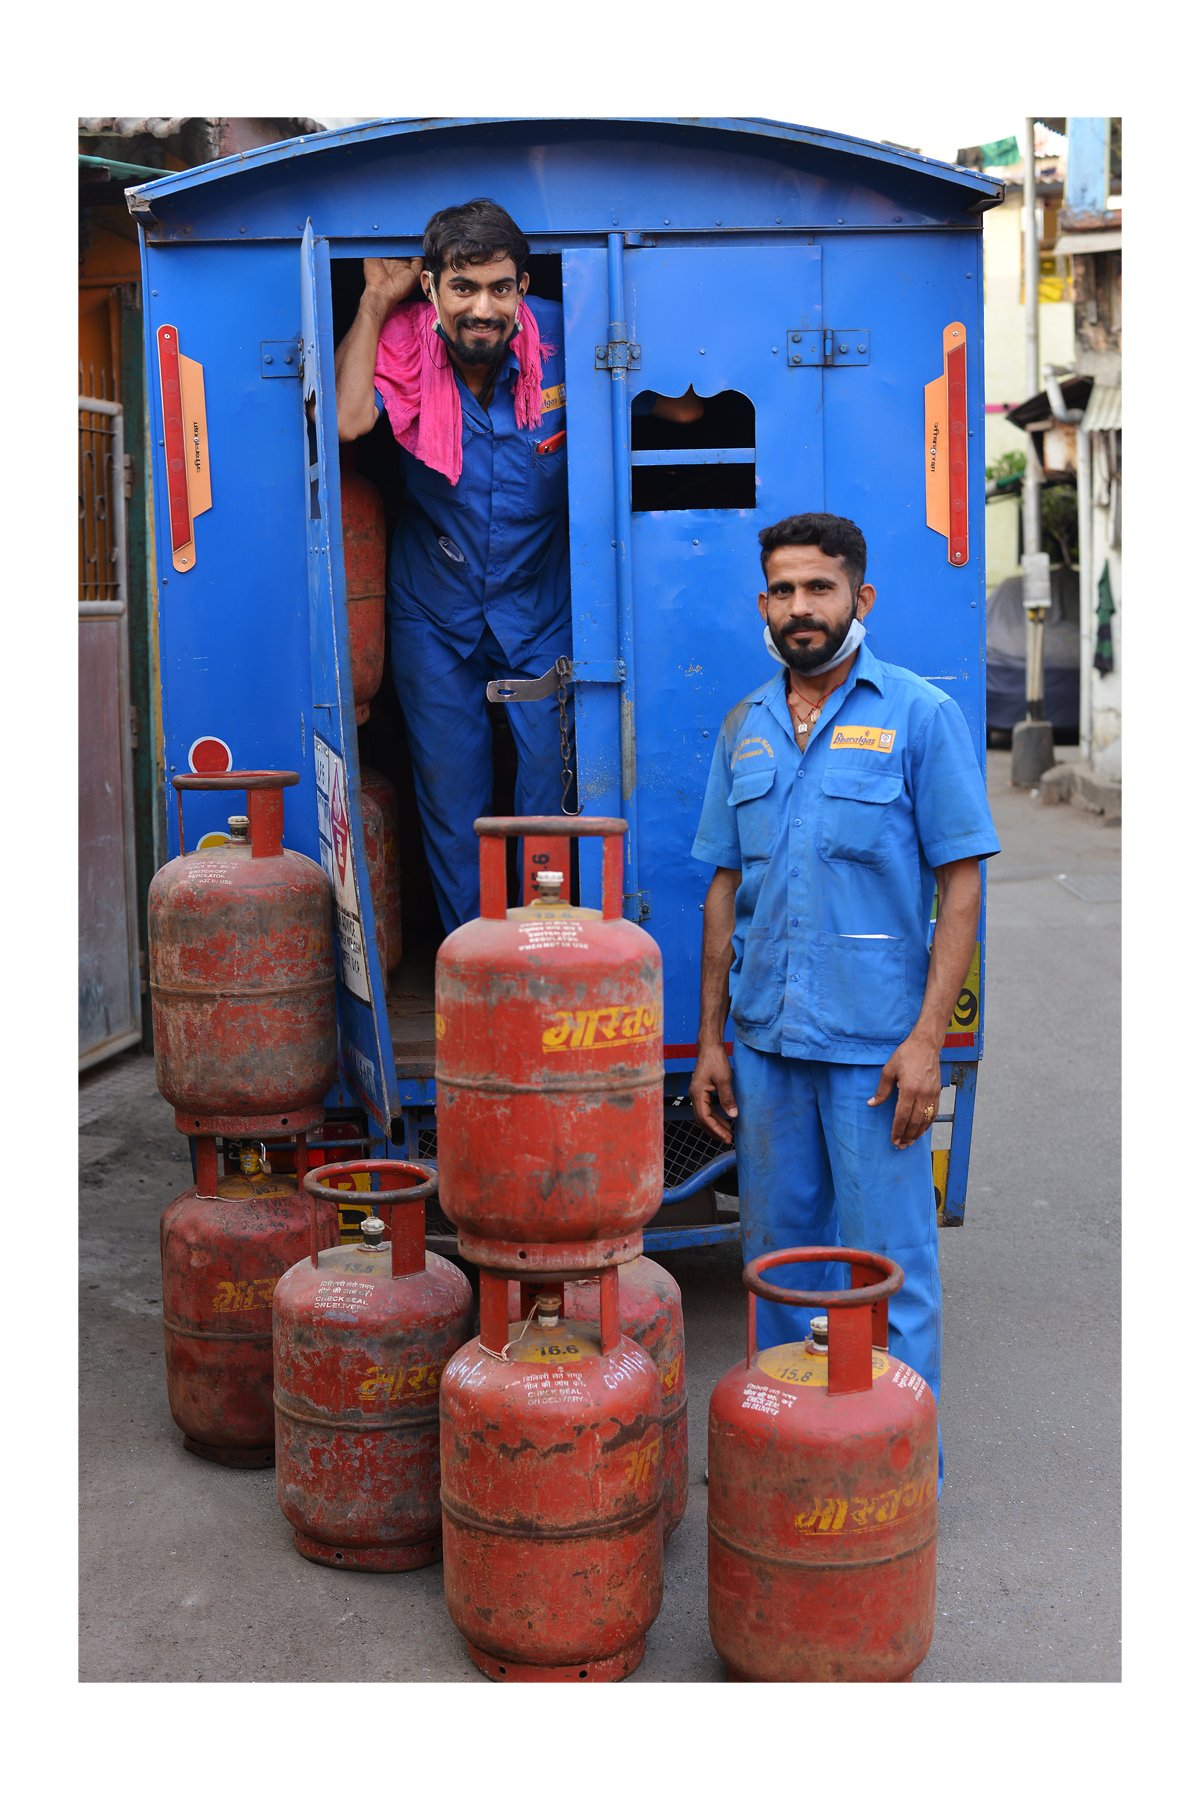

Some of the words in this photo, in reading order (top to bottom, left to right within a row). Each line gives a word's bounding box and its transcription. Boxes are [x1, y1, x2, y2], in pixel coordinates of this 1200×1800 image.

[833, 731, 876, 746] Bharatgas
[948, 987, 978, 1027] 9
[541, 1344, 579, 1356] 16.6
[780, 1367, 813, 1383] 15.8
